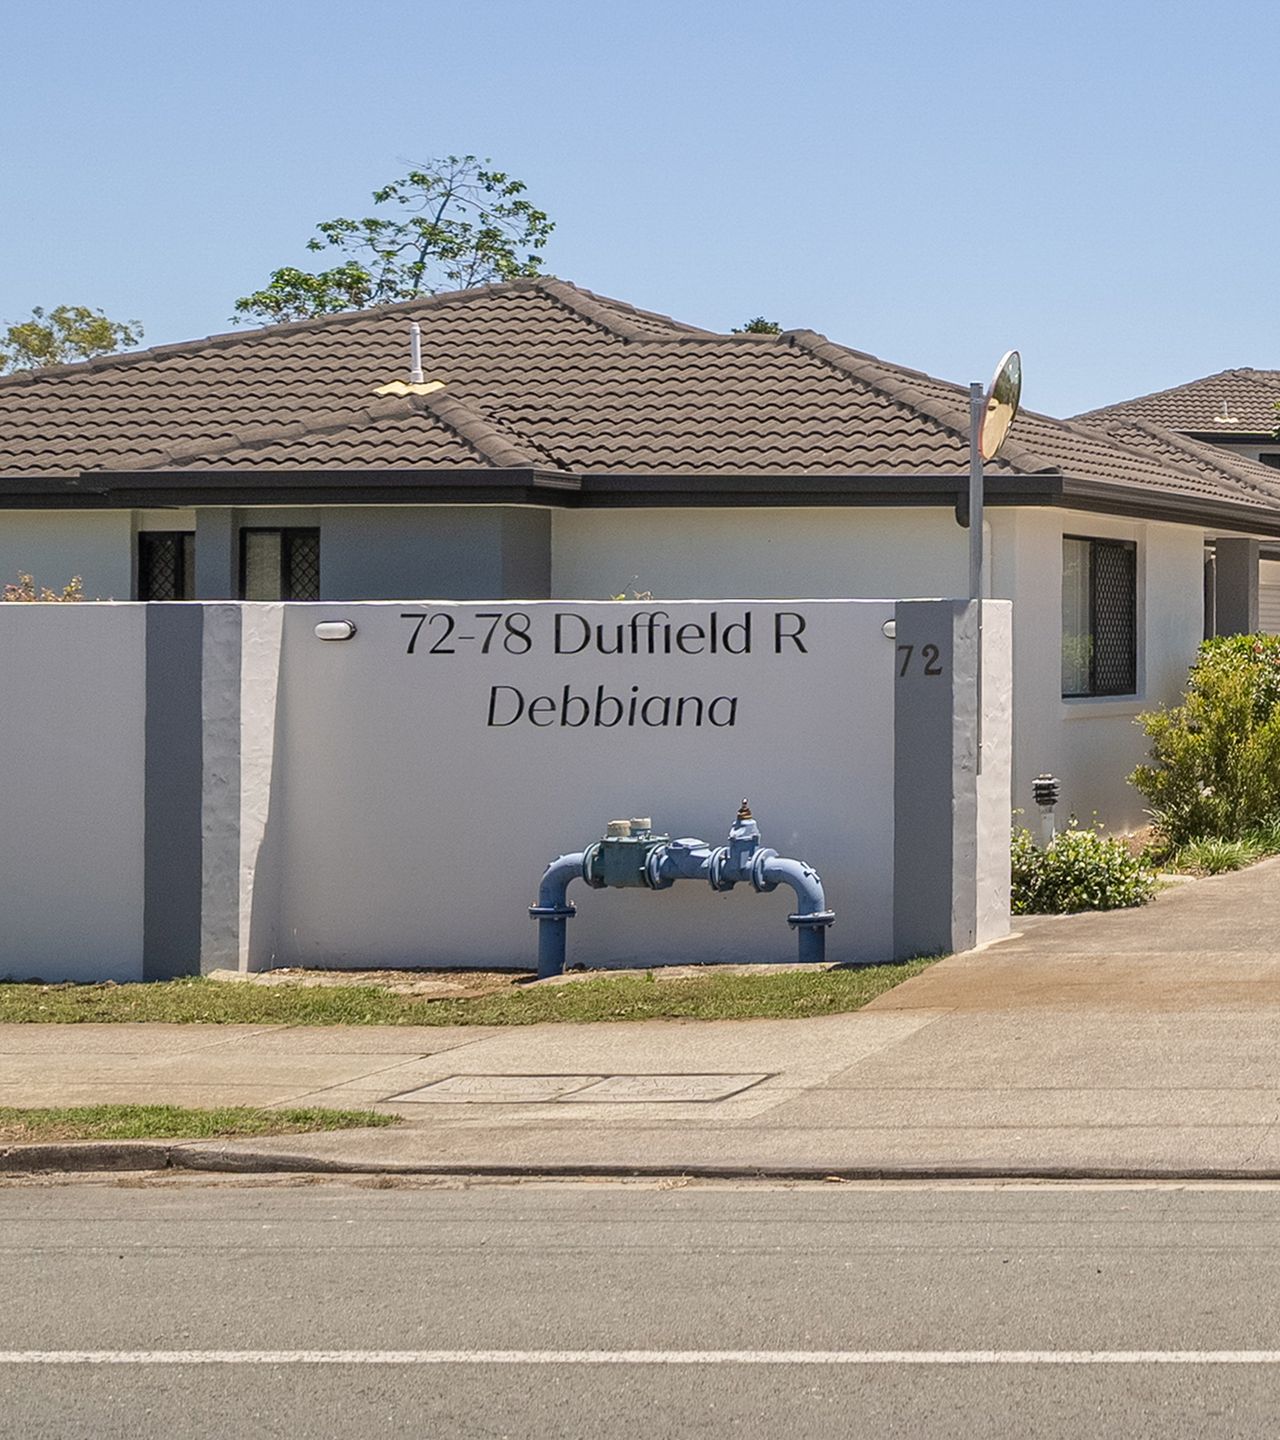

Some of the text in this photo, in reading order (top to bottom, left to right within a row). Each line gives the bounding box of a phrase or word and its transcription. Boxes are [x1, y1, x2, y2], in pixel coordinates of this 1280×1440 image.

[399, 610, 809, 656] 72-78 Duffield R
[897, 643, 944, 678] 72
[486, 683, 740, 728] Debbiana
